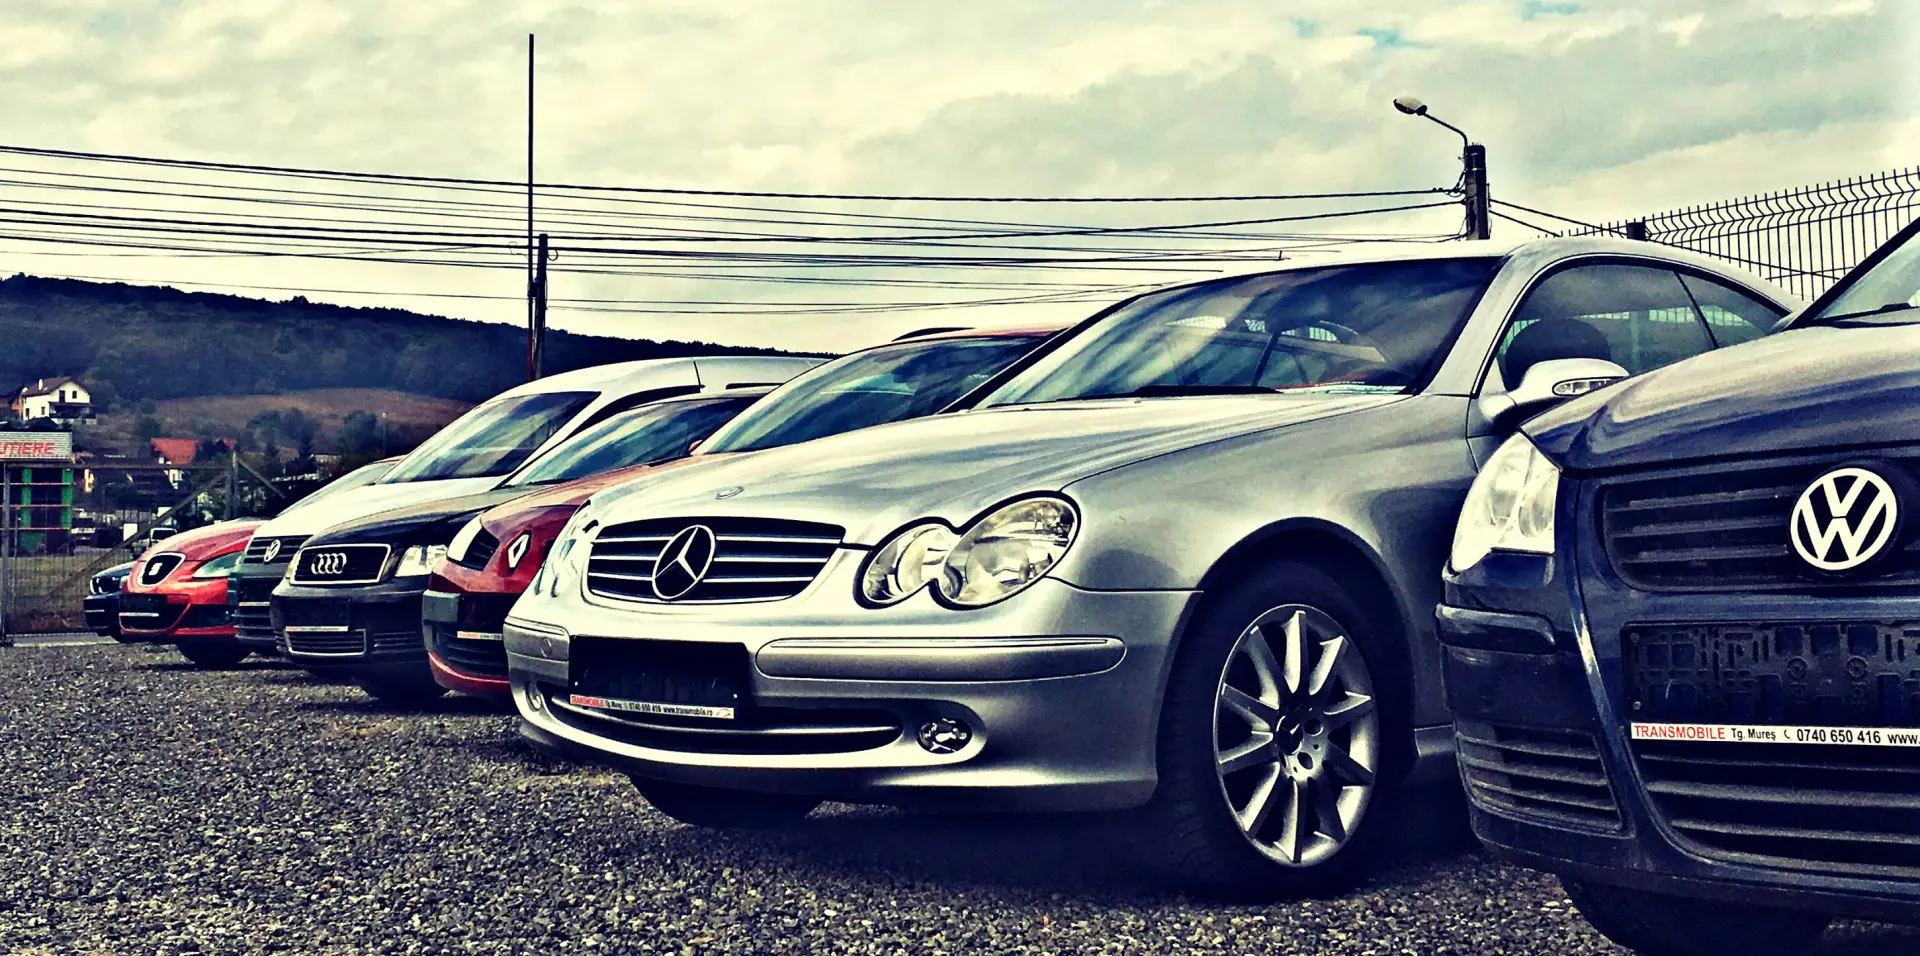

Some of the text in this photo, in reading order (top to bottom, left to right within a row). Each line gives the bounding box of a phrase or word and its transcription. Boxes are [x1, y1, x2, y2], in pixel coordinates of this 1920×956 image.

[1633, 725, 1726, 740] TRANSMOBILE
[1731, 728, 1746, 741] Tg.
[1796, 728, 1827, 742] 0740
[1829, 730, 1853, 743] 650
[1857, 730, 1882, 744] 416
